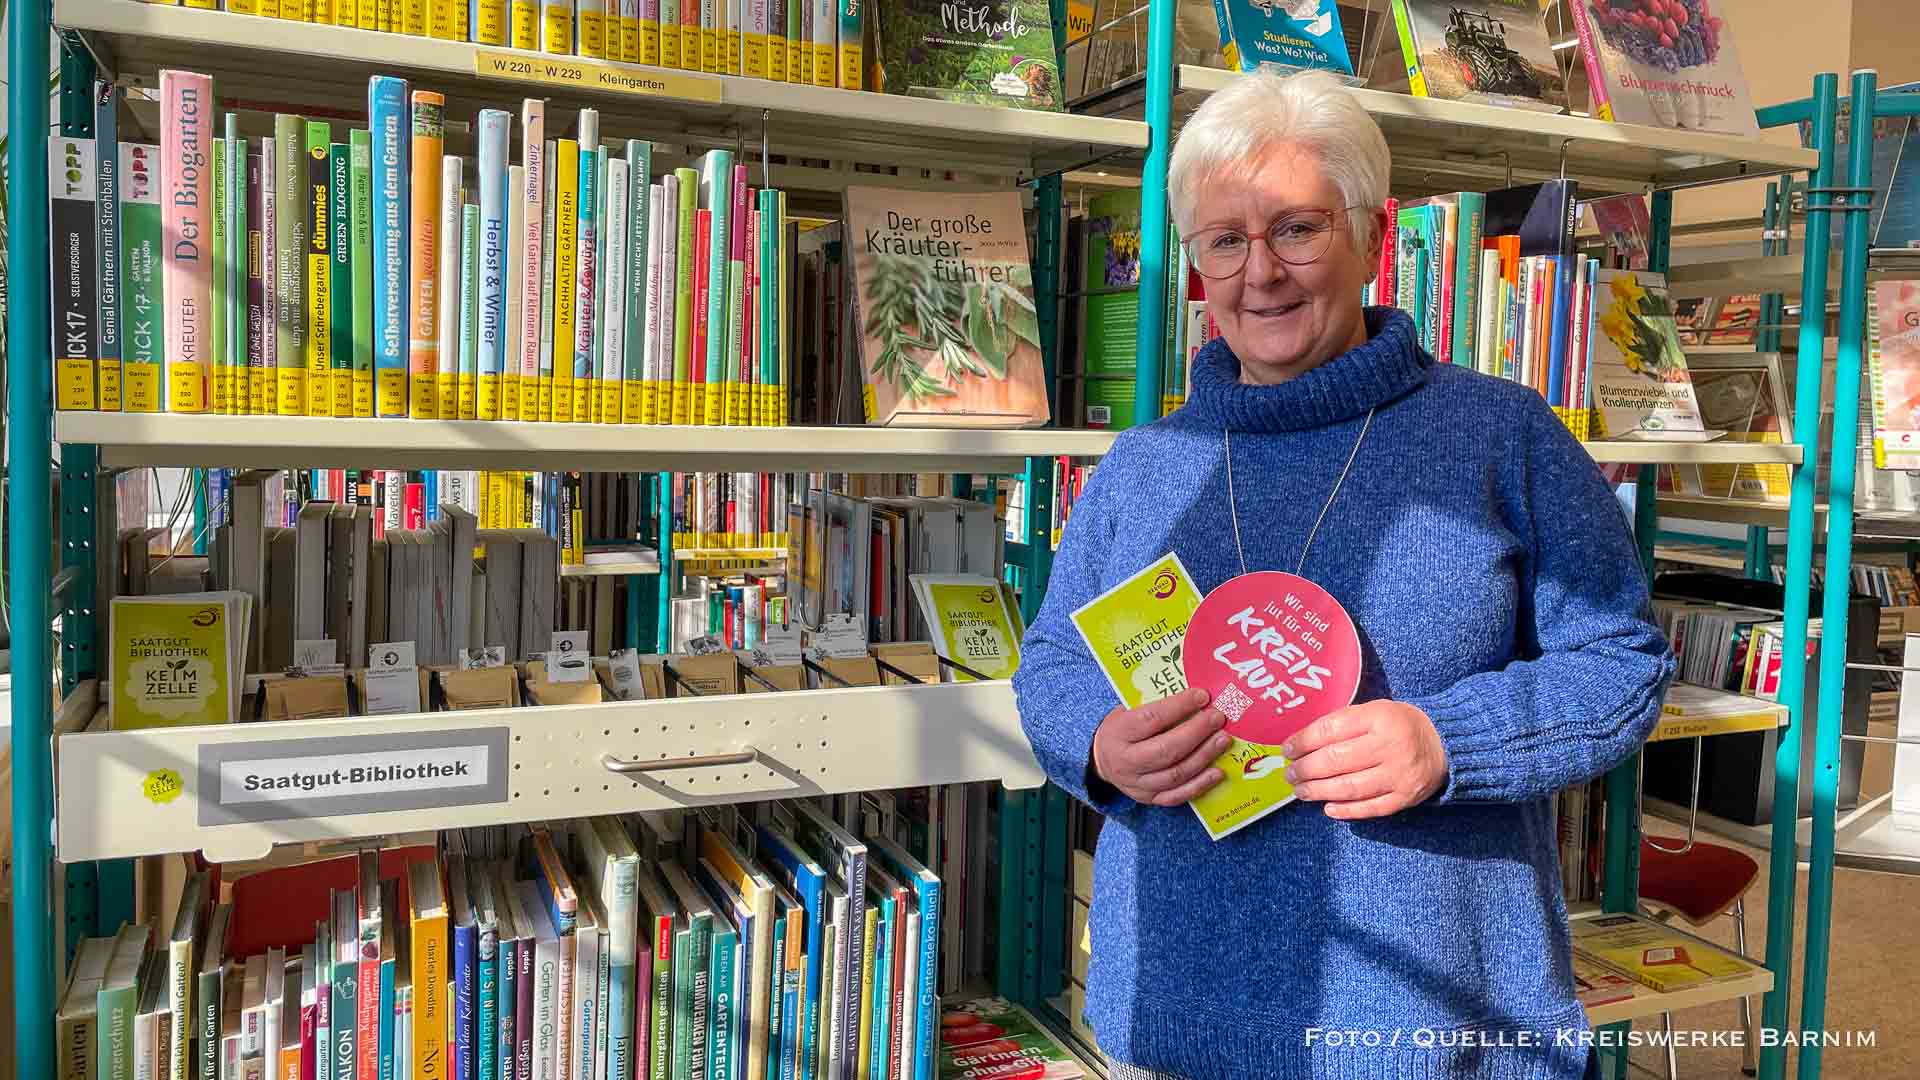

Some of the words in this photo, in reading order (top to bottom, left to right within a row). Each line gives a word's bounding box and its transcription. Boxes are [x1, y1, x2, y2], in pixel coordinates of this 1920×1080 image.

[941, 3, 1031, 38] Methode
[1254, 40, 1281, 56] Was?
[1282, 45, 1303, 58] Wo?
[1304, 49, 1328, 63] Wie?
[1263, 30, 1315, 49] Studieren.
[493, 59, 507, 71] W
[510, 62, 531, 73] 220
[545, 64, 558, 77] W
[561, 68, 582, 80] 229
[599, 72, 665, 91] Kleingarten
[1619, 74, 1735, 99] Blumenschmuck
[174, 88, 206, 210] Biogarten
[384, 115, 398, 167] Garten
[66, 142, 81, 195] TOPP
[132, 146, 148, 199] TOPP
[384, 167, 399, 199] dem
[527, 143, 541, 208] Zinkernagel
[101, 159, 113, 226] Strohballen
[336, 157, 346, 219] BLOGGING
[636, 186, 644, 211] WANN
[267, 197, 275, 256] PERMAKULTUR
[386, 202, 399, 228] aus
[528, 222, 541, 241] Viel
[561, 191, 572, 251] GÄRTNERN
[887, 211, 921, 233] Der
[930, 215, 992, 239] große
[1567, 197, 1577, 236] Ikebana
[103, 227, 113, 248] mit
[175, 215, 199, 262] Der
[337, 221, 347, 263] GREEN
[487, 218, 502, 273] Herbst
[865, 228, 973, 257] Kräuter-
[70, 231, 81, 298] SELBSTVERSORGER
[103, 249, 114, 304] Gärtnern
[290, 221, 305, 306] Selbstversorgung
[528, 243, 540, 279] Garten
[933, 258, 1015, 284] führer
[278, 248, 292, 322] Familiengarten
[315, 257, 327, 338] Schrebergarten
[384, 229, 401, 357] Selbstversorgung
[485, 276, 500, 288] &
[527, 280, 538, 298] auf
[560, 254, 571, 325] NACHHALTIG
[66, 311, 87, 329] 17
[104, 306, 115, 344] Genial
[266, 291, 274, 338] PFLANZEN
[418, 279, 432, 337] GARTEN
[484, 294, 499, 347] Winter
[526, 298, 538, 338] kleinem
[182, 297, 196, 362] KREUTER
[293, 323, 304, 347] dem
[579, 303, 591, 353] Kräuter
[315, 340, 325, 371] Unser
[525, 341, 537, 369] Raum
[1599, 383, 1670, 399] Blumenzwiebel-
[1672, 387, 1689, 399] und
[1602, 396, 1675, 410] Knollenpflanzen
[388, 475, 399, 530] Mavericks
[562, 498, 571, 549] Datenbanken
[947, 611, 985, 620] SAATGUT
[950, 618, 998, 628] BIBLIOTHEK
[1263, 601, 1283, 621] jut
[1282, 613, 1302, 634] für
[1300, 628, 1323, 652] den
[1283, 592, 1305, 613] Wir
[1303, 608, 1330, 634] sind
[130, 637, 191, 647] SAATGUT
[130, 647, 209, 658] BIBLIOTHEK
[964, 636, 997, 647] KEIM
[968, 646, 1000, 657] ZELLE
[1113, 618, 1169, 658] SAATGUT
[1227, 606, 1332, 691] KREIS
[145, 670, 197, 682] KEIM
[145, 682, 198, 695] ZELLE
[152, 784, 177, 797] ZELLE
[244, 760, 469, 791] Saatgut-Bibliothek
[854, 860, 865, 914] PAVILLONS
[426, 938, 437, 975] Charles
[720, 945, 729, 973] LEBEN
[852, 923, 862, 966] LAUBEN
[922, 887, 938, 1007] Gartendeko-Buch
[176, 961, 187, 999] Garten?
[426, 976, 438, 1019] Dowding
[462, 963, 474, 996] Foerster
[541, 960, 555, 1003] Gärten
[559, 957, 572, 1026] GESTALTEN
[657, 970, 669, 1017] gestalten
[319, 996, 329, 1024] Praxis
[359, 968, 370, 1031] Küchengarten
[460, 998, 473, 1021] Karl
[690, 970, 707, 1046] HEIMWERKEN
[848, 967, 860, 1052] GARTENHÄUSER,
[176, 1014, 185, 1040] wann
[204, 1003, 216, 1038] Garten
[460, 1023, 472, 1051] Vaters
[540, 1022, 553, 1051] Glas
[894, 989, 904, 1057] Nützlingshotels
[175, 1041, 184, 1056] ich
[204, 1040, 215, 1059] den
[655, 1018, 668, 1080] Naturgärten
[952, 1045, 1042, 1068] Gärtnern
[962, 1063, 1011, 1079] ohne
[1012, 1053, 1052, 1070] Gift
[204, 1060, 215, 1076] für
